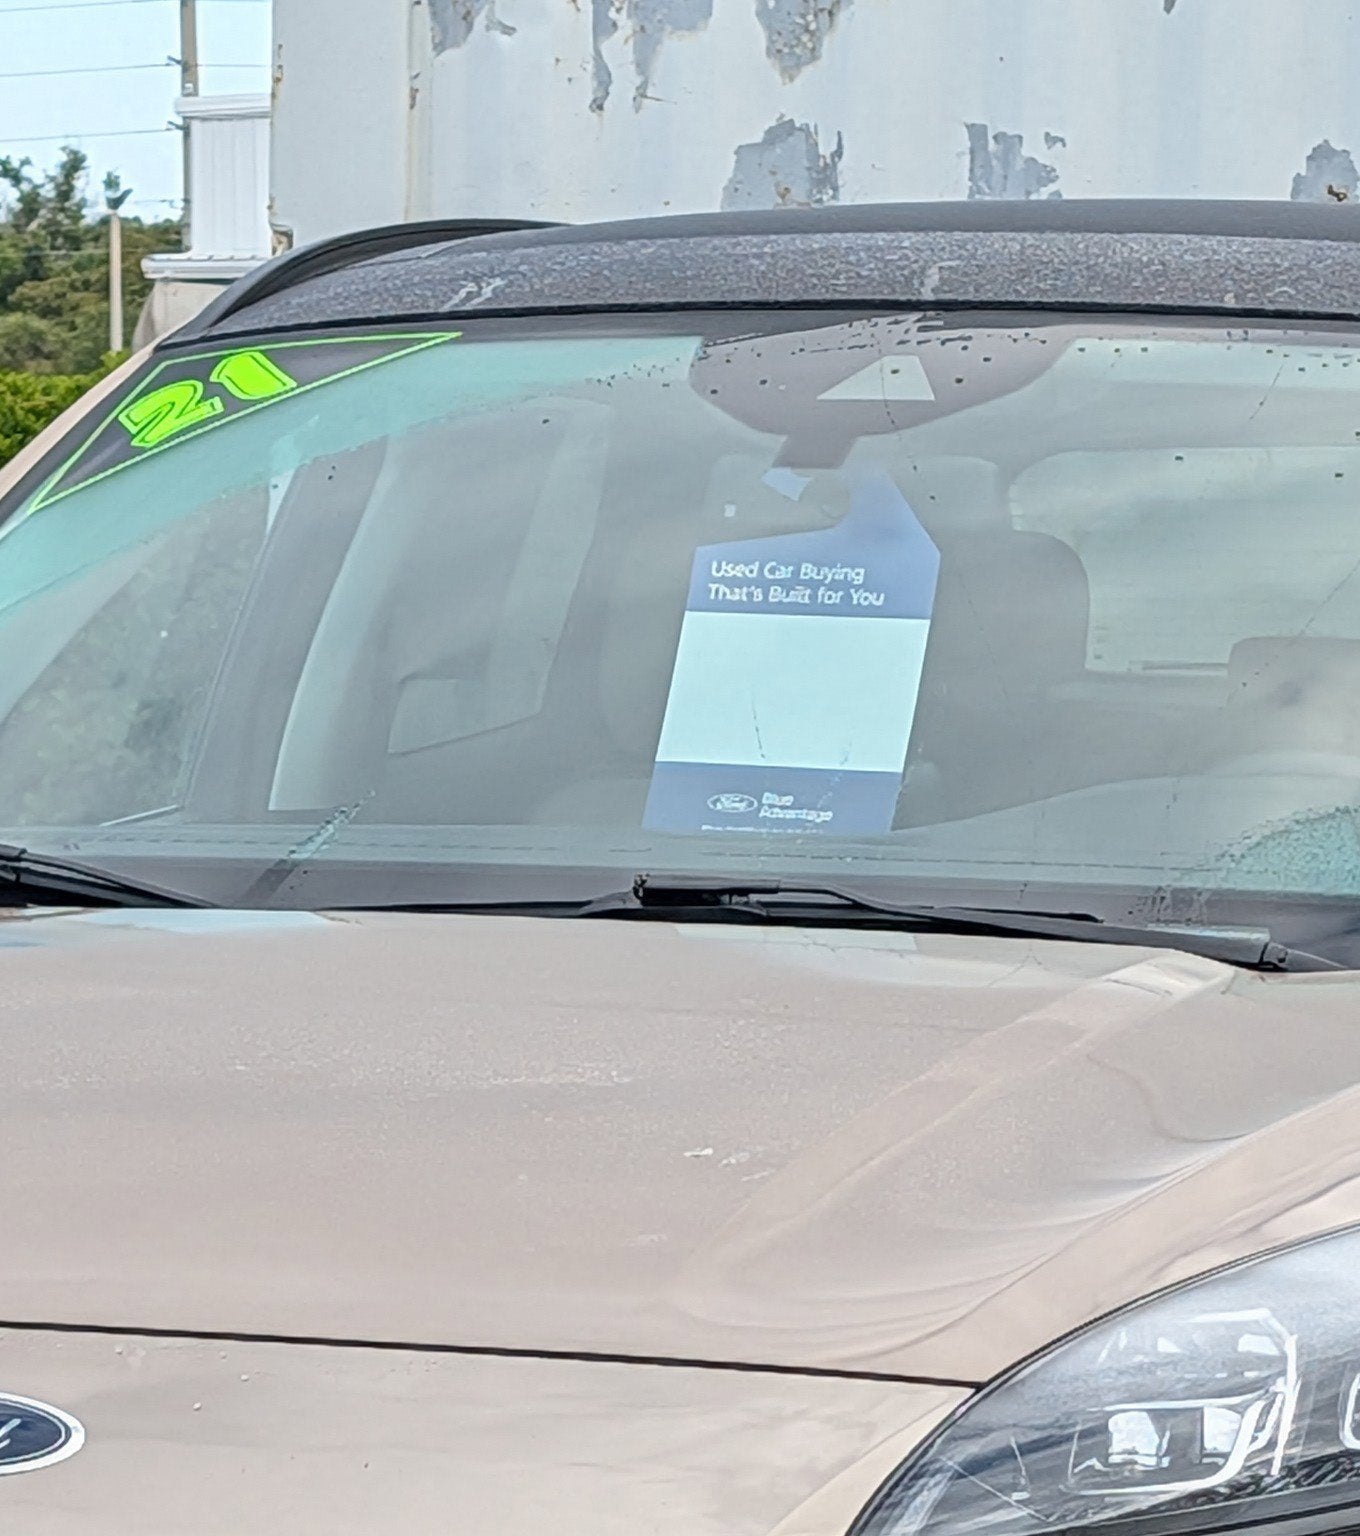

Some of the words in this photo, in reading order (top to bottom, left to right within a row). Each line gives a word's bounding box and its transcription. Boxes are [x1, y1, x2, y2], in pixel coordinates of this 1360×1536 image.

[118, 351, 297, 449] 21
[711, 560, 759, 578] Used
[764, 561, 793, 580] Car
[800, 563, 865, 584] Buying
[709, 583, 763, 602] That's
[769, 586, 810, 604] Built
[817, 587, 844, 605] for
[850, 588, 885, 606] You
